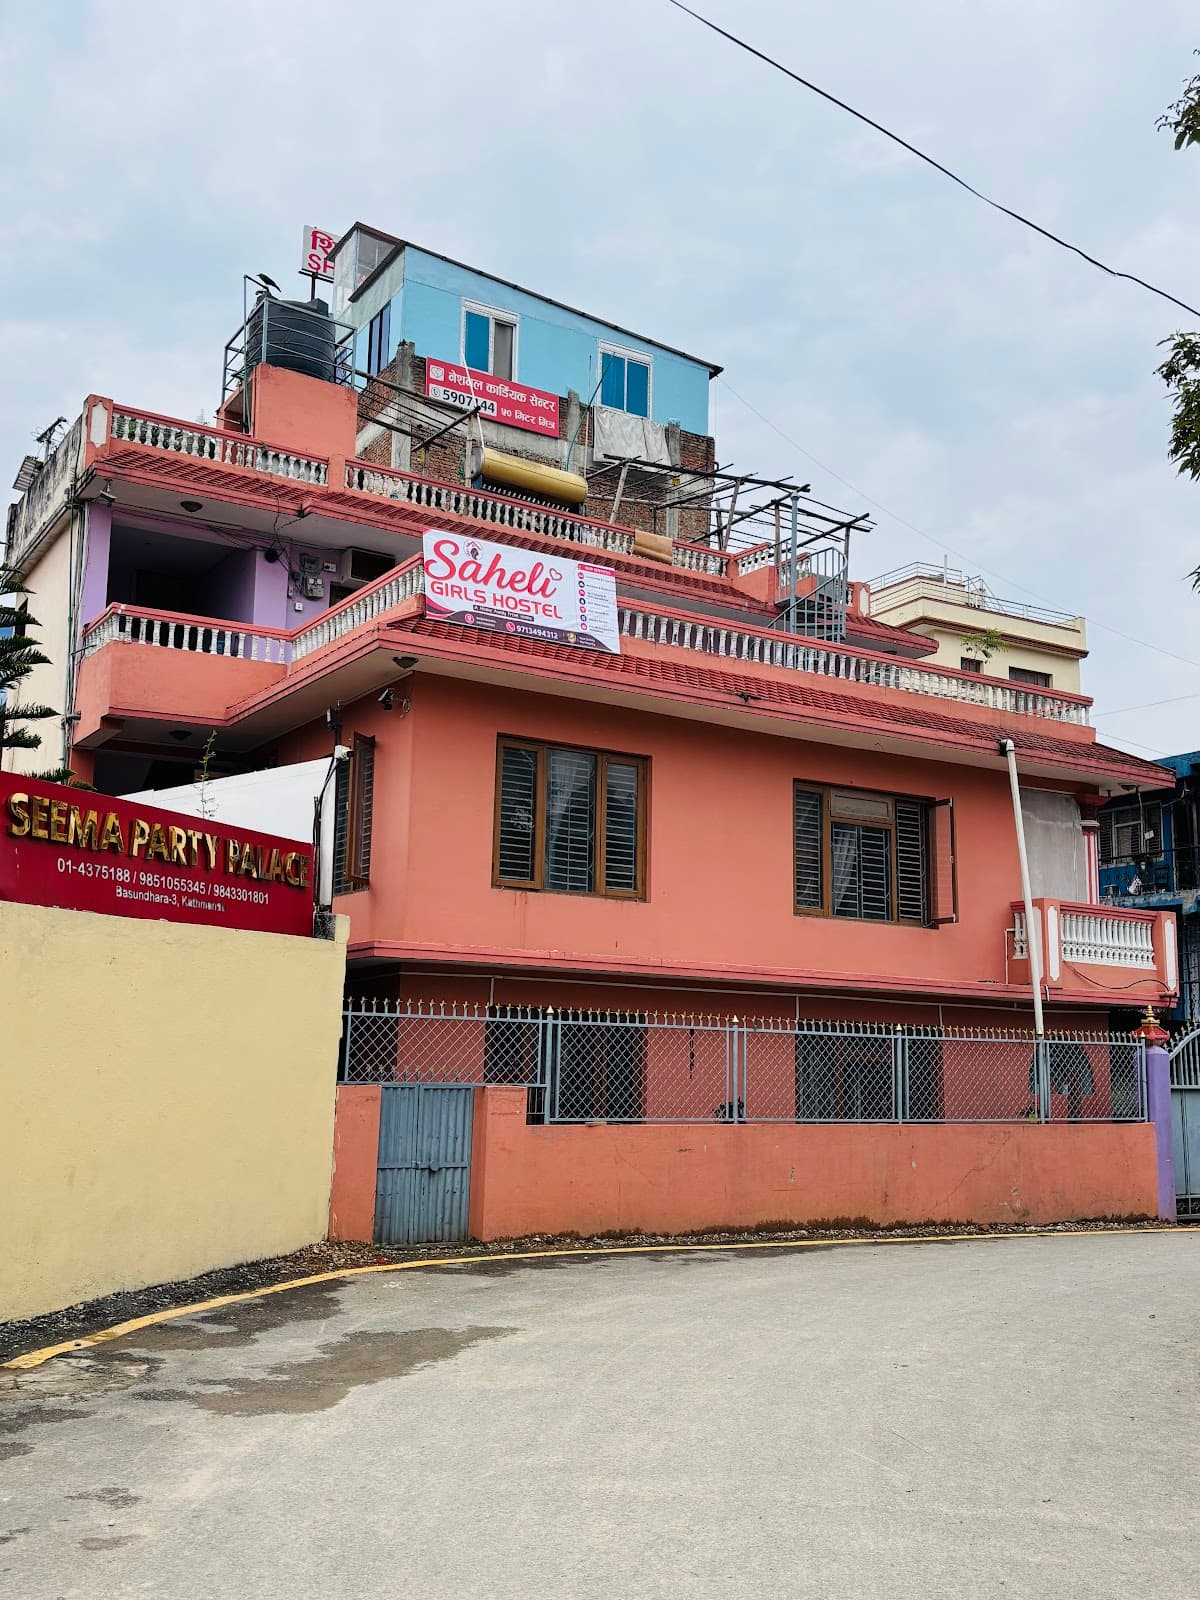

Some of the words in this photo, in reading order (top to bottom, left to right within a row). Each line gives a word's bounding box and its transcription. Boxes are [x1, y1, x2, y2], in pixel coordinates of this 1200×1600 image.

[448, 369, 483, 391] नेशनल
[529, 393, 556, 413] सेन्टर
[424, 539, 561, 599] Saheli
[430, 580, 487, 605] GIRLS
[492, 593, 563, 620] HOSTEL
[9, 792, 125, 854] SEEMA
[130, 818, 219, 869] PARTY
[225, 838, 310, 888] PALACE
[57, 857, 130, 883] 01-4375188
[139, 873, 206, 895] 9851055345
[213, 884, 269, 904] 9843301801
[115, 885, 180, 907] Basundhara-3,
